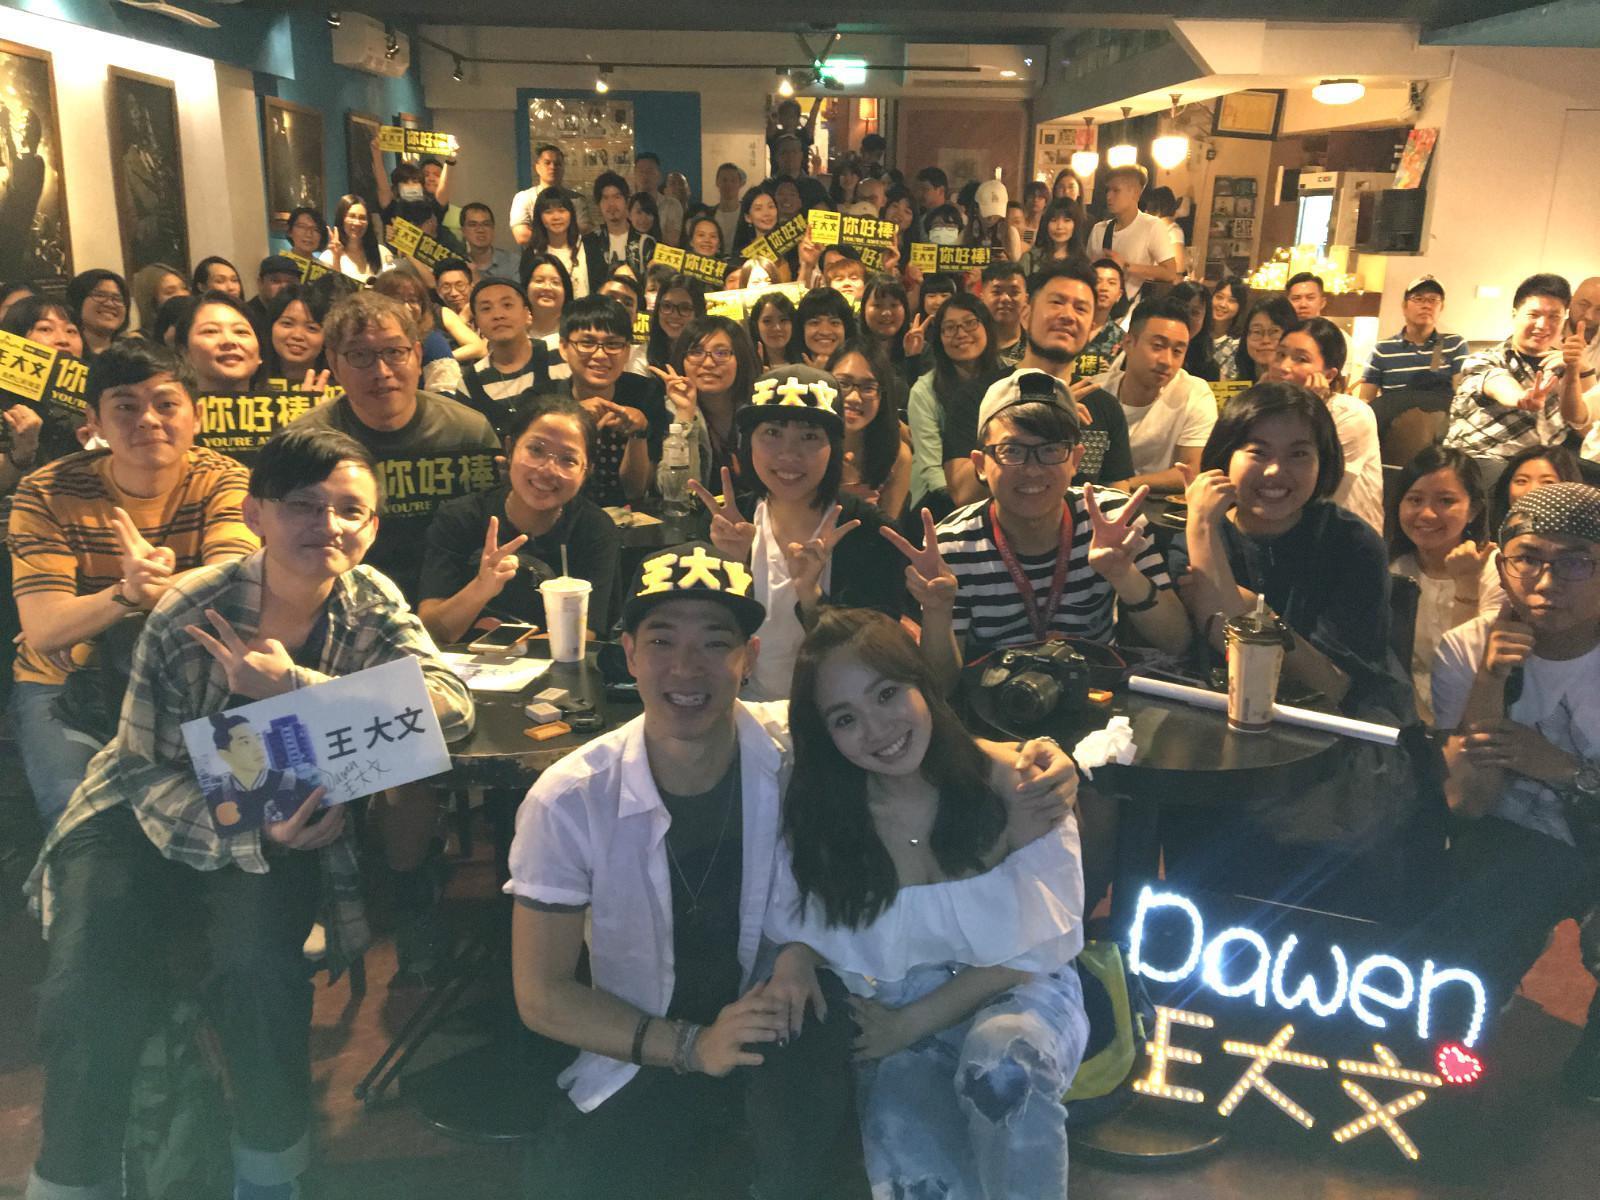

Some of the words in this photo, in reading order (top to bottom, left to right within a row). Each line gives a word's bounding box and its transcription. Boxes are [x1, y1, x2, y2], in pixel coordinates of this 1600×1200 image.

[202, 436, 254, 447] YOU'RE
[325, 706, 426, 760] 王大文
[1129, 885, 1486, 1048] Dawen
[1132, 1004, 1443, 1161] 王大文
